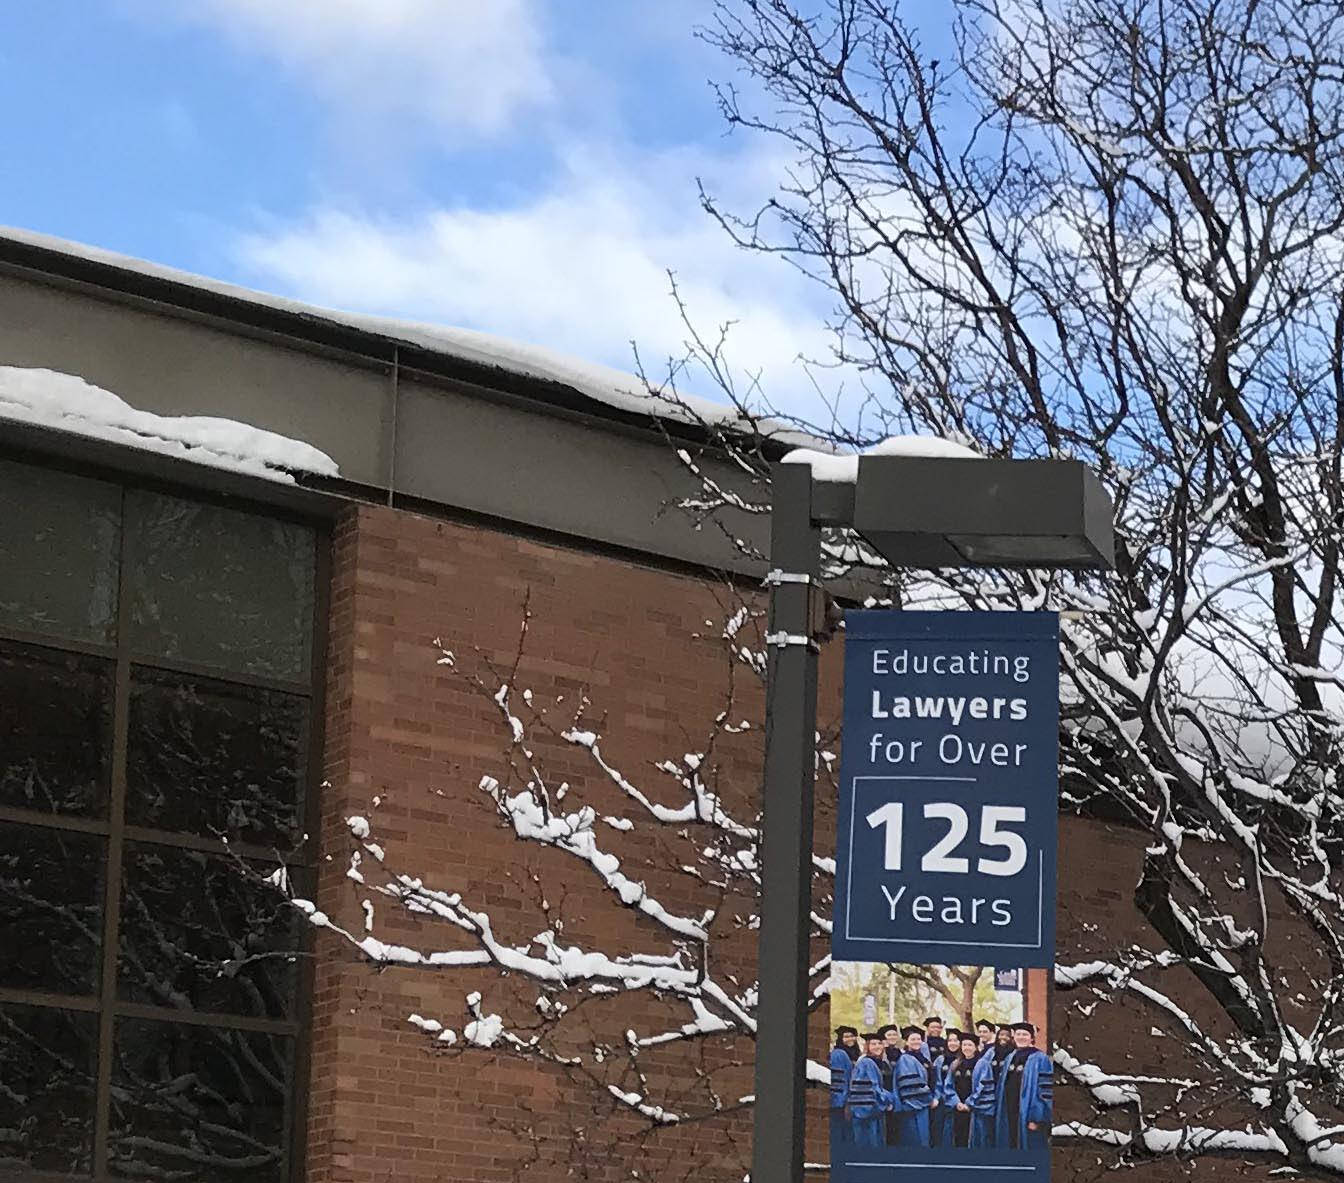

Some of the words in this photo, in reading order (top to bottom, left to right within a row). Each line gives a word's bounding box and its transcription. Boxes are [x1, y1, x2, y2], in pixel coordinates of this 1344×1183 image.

[872, 649, 1030, 683] Educating
[872, 690, 1028, 725] Lawyers
[869, 733, 923, 763] for
[939, 733, 1028, 766] Over
[865, 802, 1028, 877] 125
[881, 885, 1012, 926] Years
